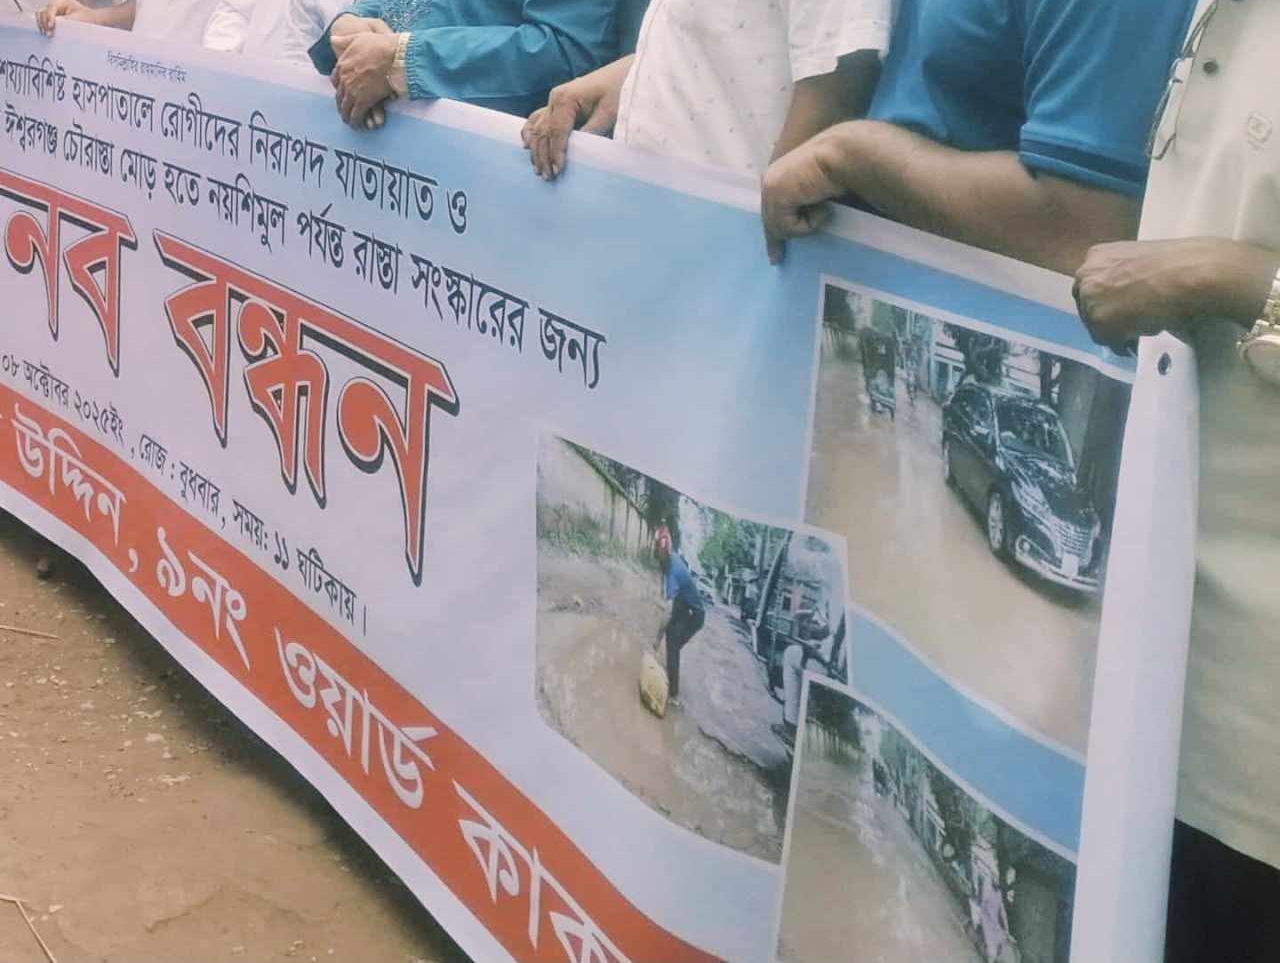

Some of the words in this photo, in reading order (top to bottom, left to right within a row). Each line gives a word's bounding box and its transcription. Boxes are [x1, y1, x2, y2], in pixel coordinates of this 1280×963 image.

[0, 54, 66, 105] শয্যাবিশিষ্ট
[72, 74, 155, 134] হাসপাতালে
[161, 92, 243, 160] রোগীদের
[249, 109, 327, 188] নিরাপদ
[334, 147, 439, 221] যাতায়াত
[447, 188, 468, 234] ও
[5, 103, 59, 154] ঈশ্বরগঞ্জ
[63, 122, 114, 177] চৌরাস্তা
[120, 147, 157, 200] মোড়
[163, 160, 202, 206] হতে
[207, 173, 288, 254] নয়শিমুল
[297, 203, 345, 268] পর্যন্ত
[353, 229, 402, 295] রাস্তা
[409, 252, 529, 354] সংস্কারের
[538, 306, 606, 390] জন্য
[2, 354, 19, 377] ০৮
[139, 434, 168, 474] রোজ
[273, 530, 290, 571] ১১
[296, 547, 357, 626] ঘটিকায়
[153, 229, 461, 586] বন্ধন
[12, 401, 127, 546] উদ্দিন
[156, 526, 250, 671] ৯নং
[275, 627, 438, 809] ওয়ার্ড
